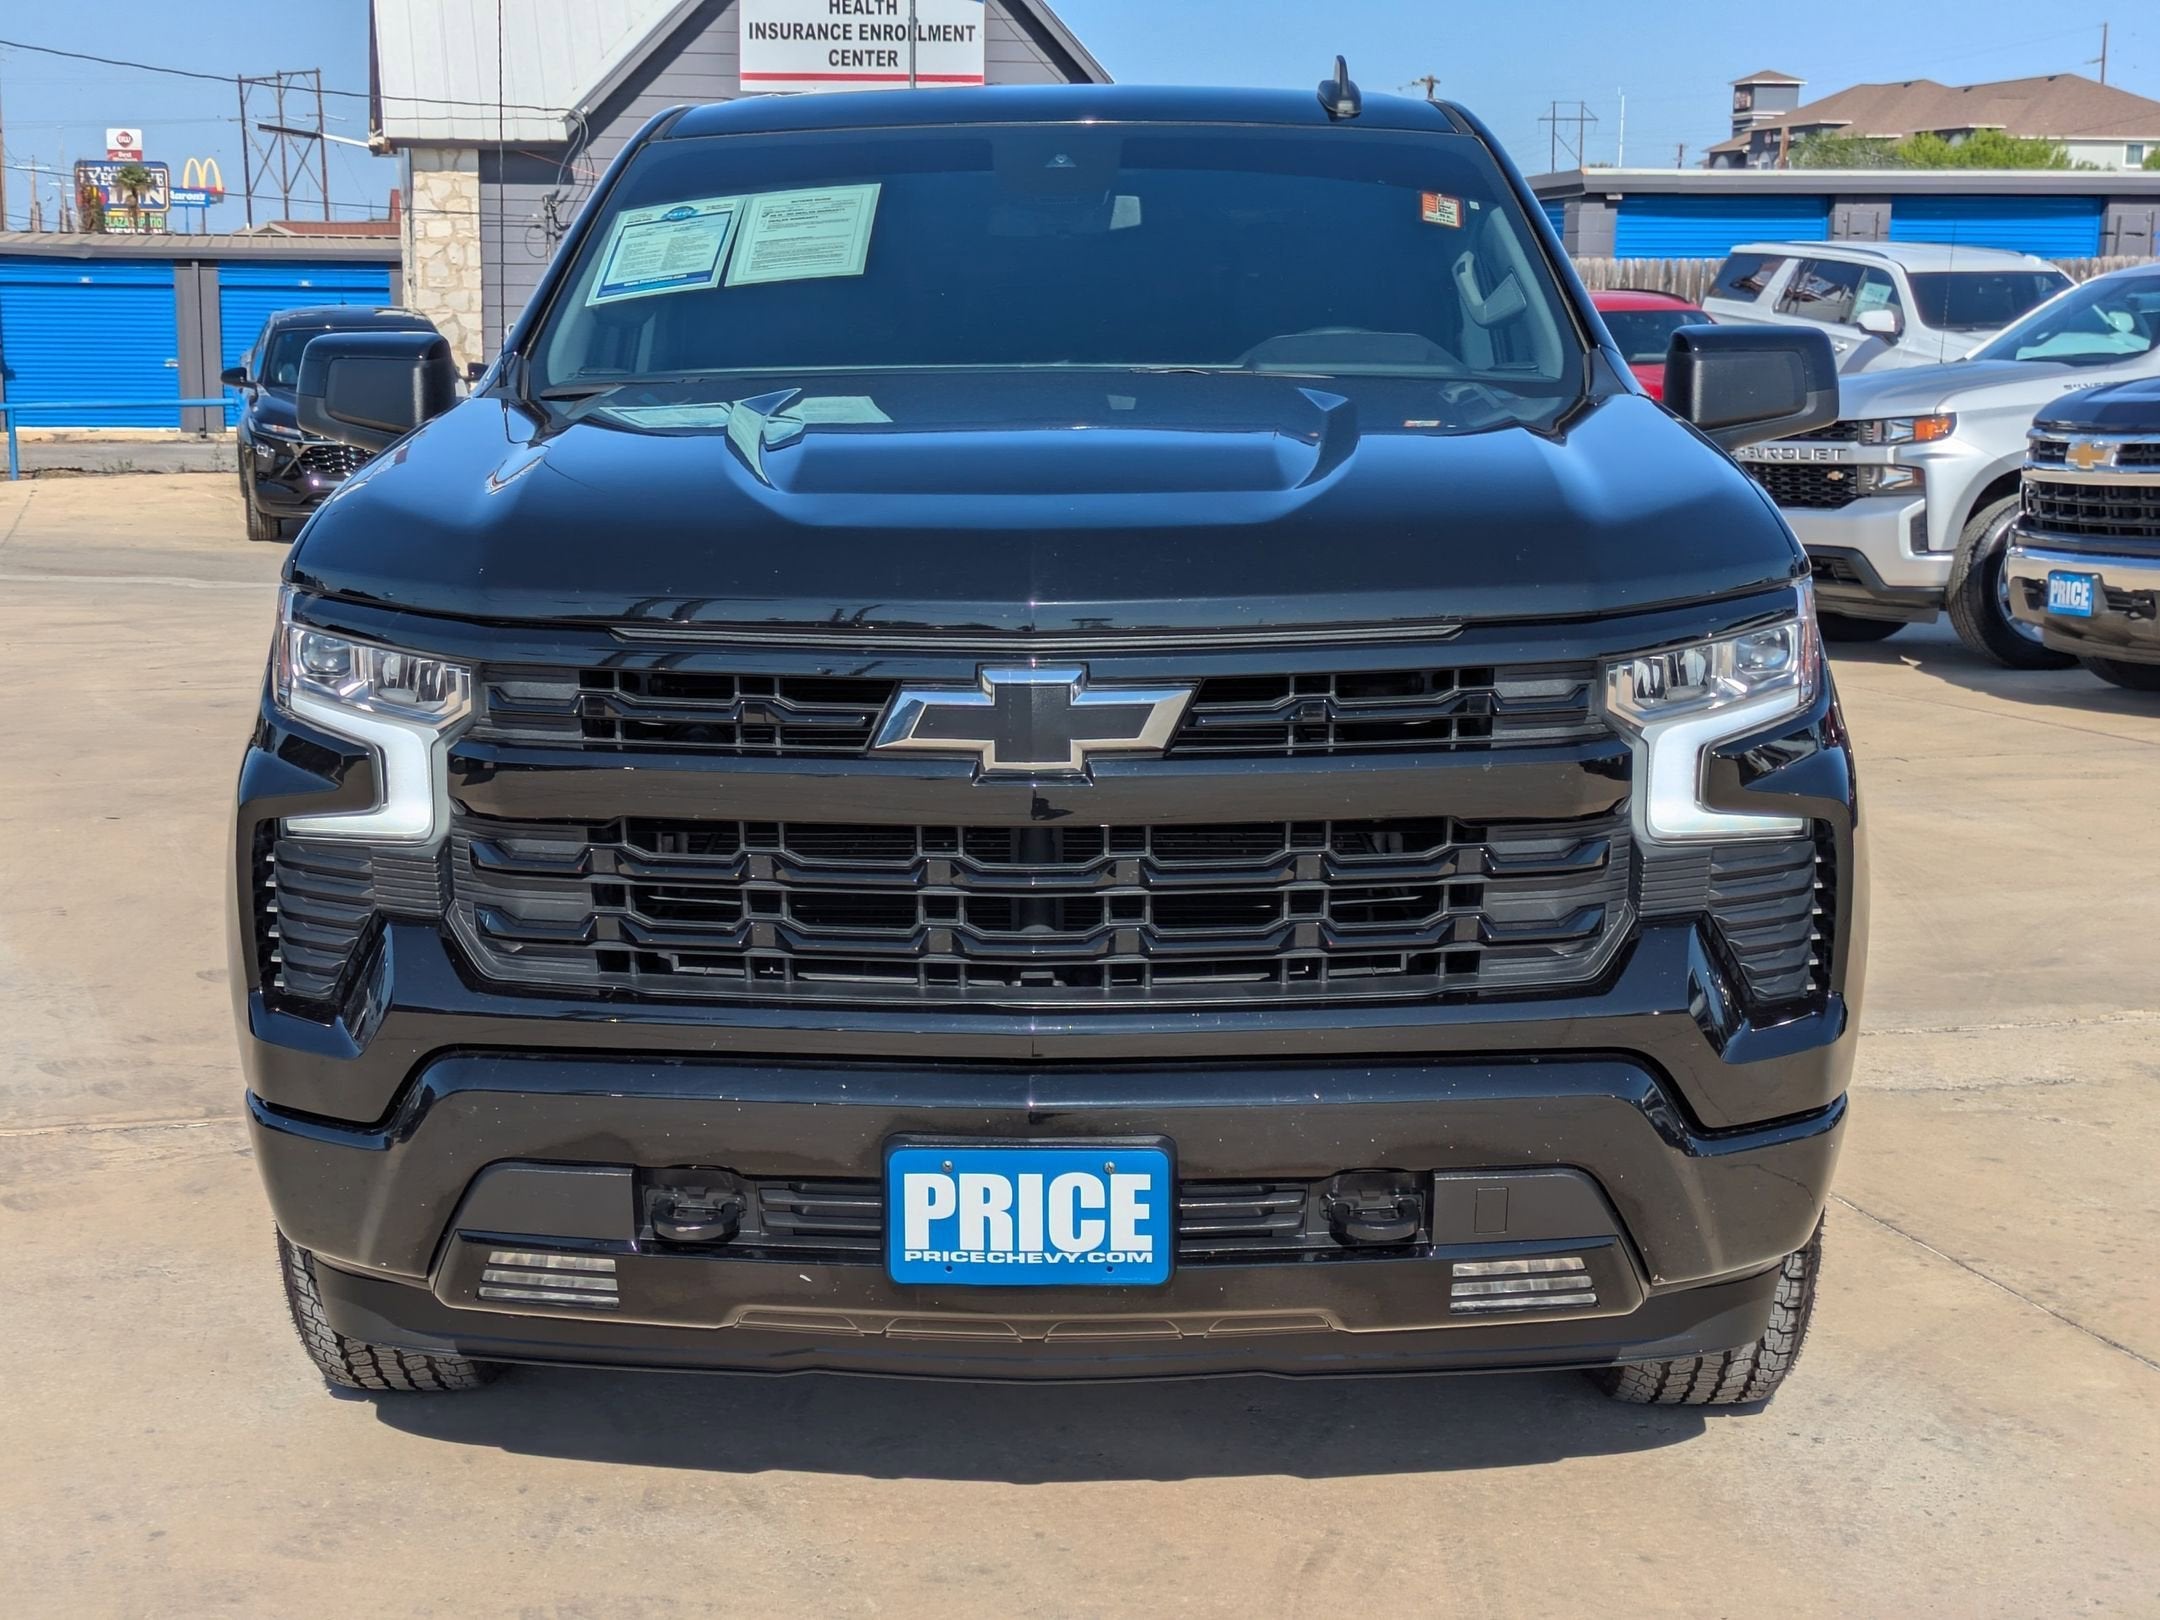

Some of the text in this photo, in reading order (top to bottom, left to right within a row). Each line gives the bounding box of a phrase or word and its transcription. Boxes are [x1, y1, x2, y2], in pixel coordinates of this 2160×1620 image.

[828, 0, 898, 16] HEALTH
[749, 22, 852, 40] INSURANCE
[828, 49, 898, 67] CENTER
[79, 168, 165, 185] EXECE
[105, 216, 163, 229] PLAZA TPTIO
[2050, 579, 2090, 608] PRICE
[904, 1172, 1152, 1253] PRICE
[904, 1251, 1153, 1264] PRICECHEVY.COM
